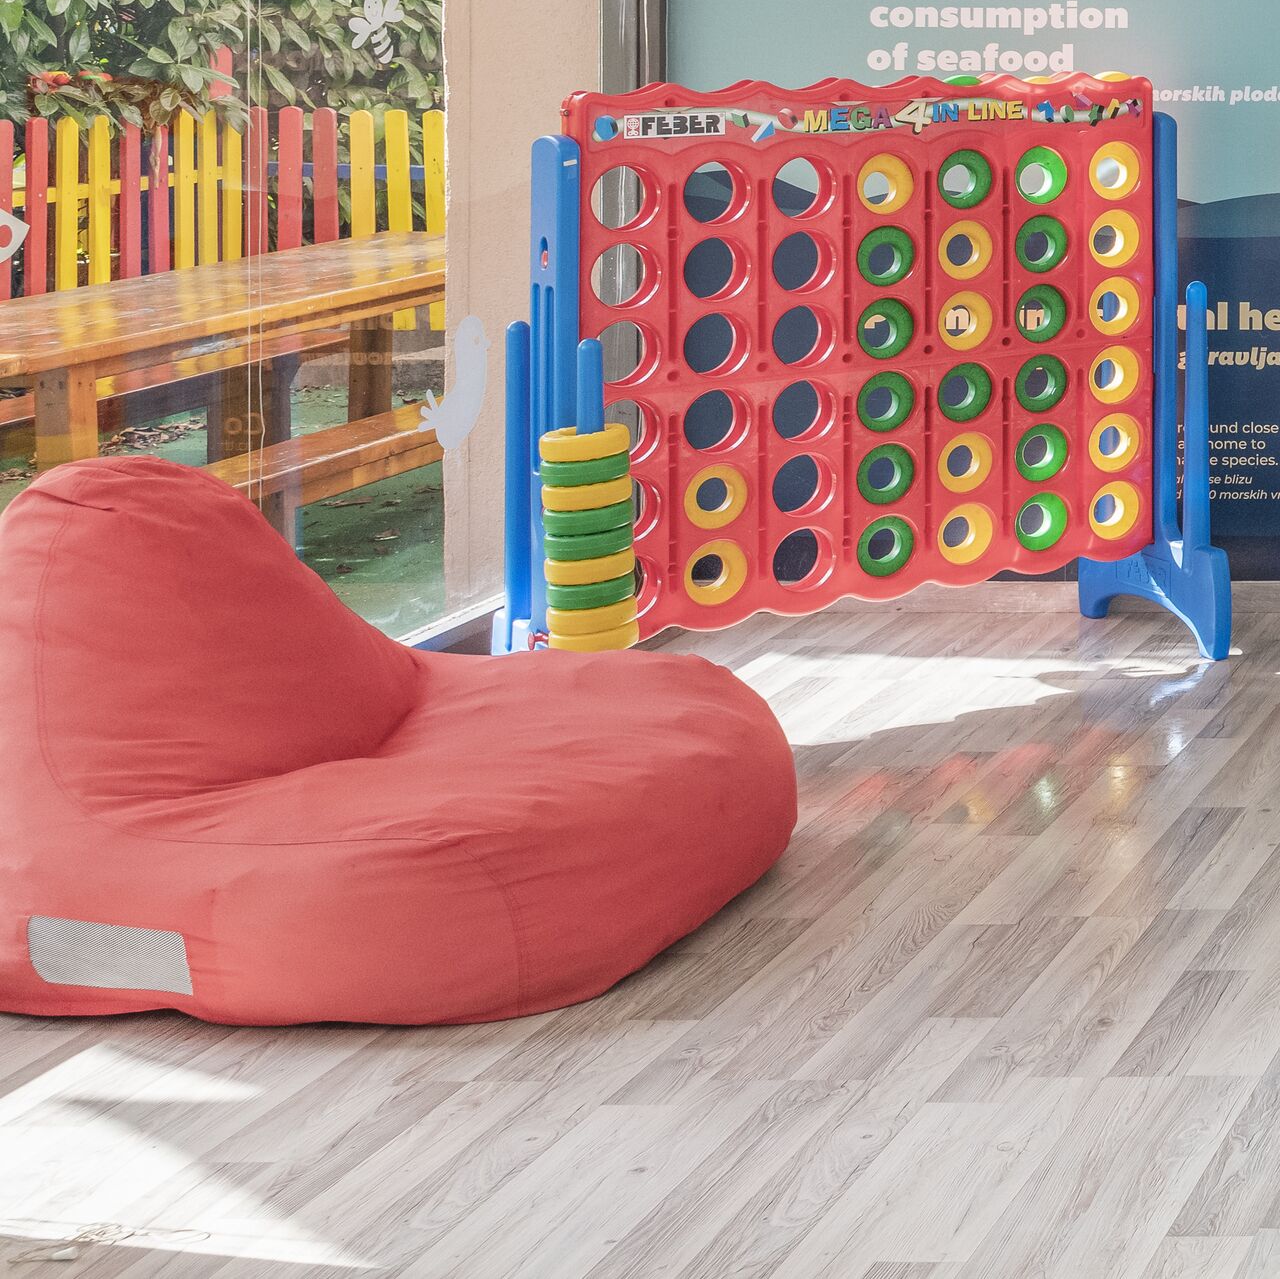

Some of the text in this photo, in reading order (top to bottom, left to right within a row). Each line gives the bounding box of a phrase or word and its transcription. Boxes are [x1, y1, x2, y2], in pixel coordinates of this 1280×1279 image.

[869, 0, 1129, 36] consumption
[866, 41, 1076, 74] of seafood
[641, 114, 723, 137] FEBER
[802, 99, 1026, 136] MEGA 4 IN LINE
[1241, 420, 1280, 434] close
[1221, 452, 1279, 469] species.
[1218, 488, 1268, 501] morskih
